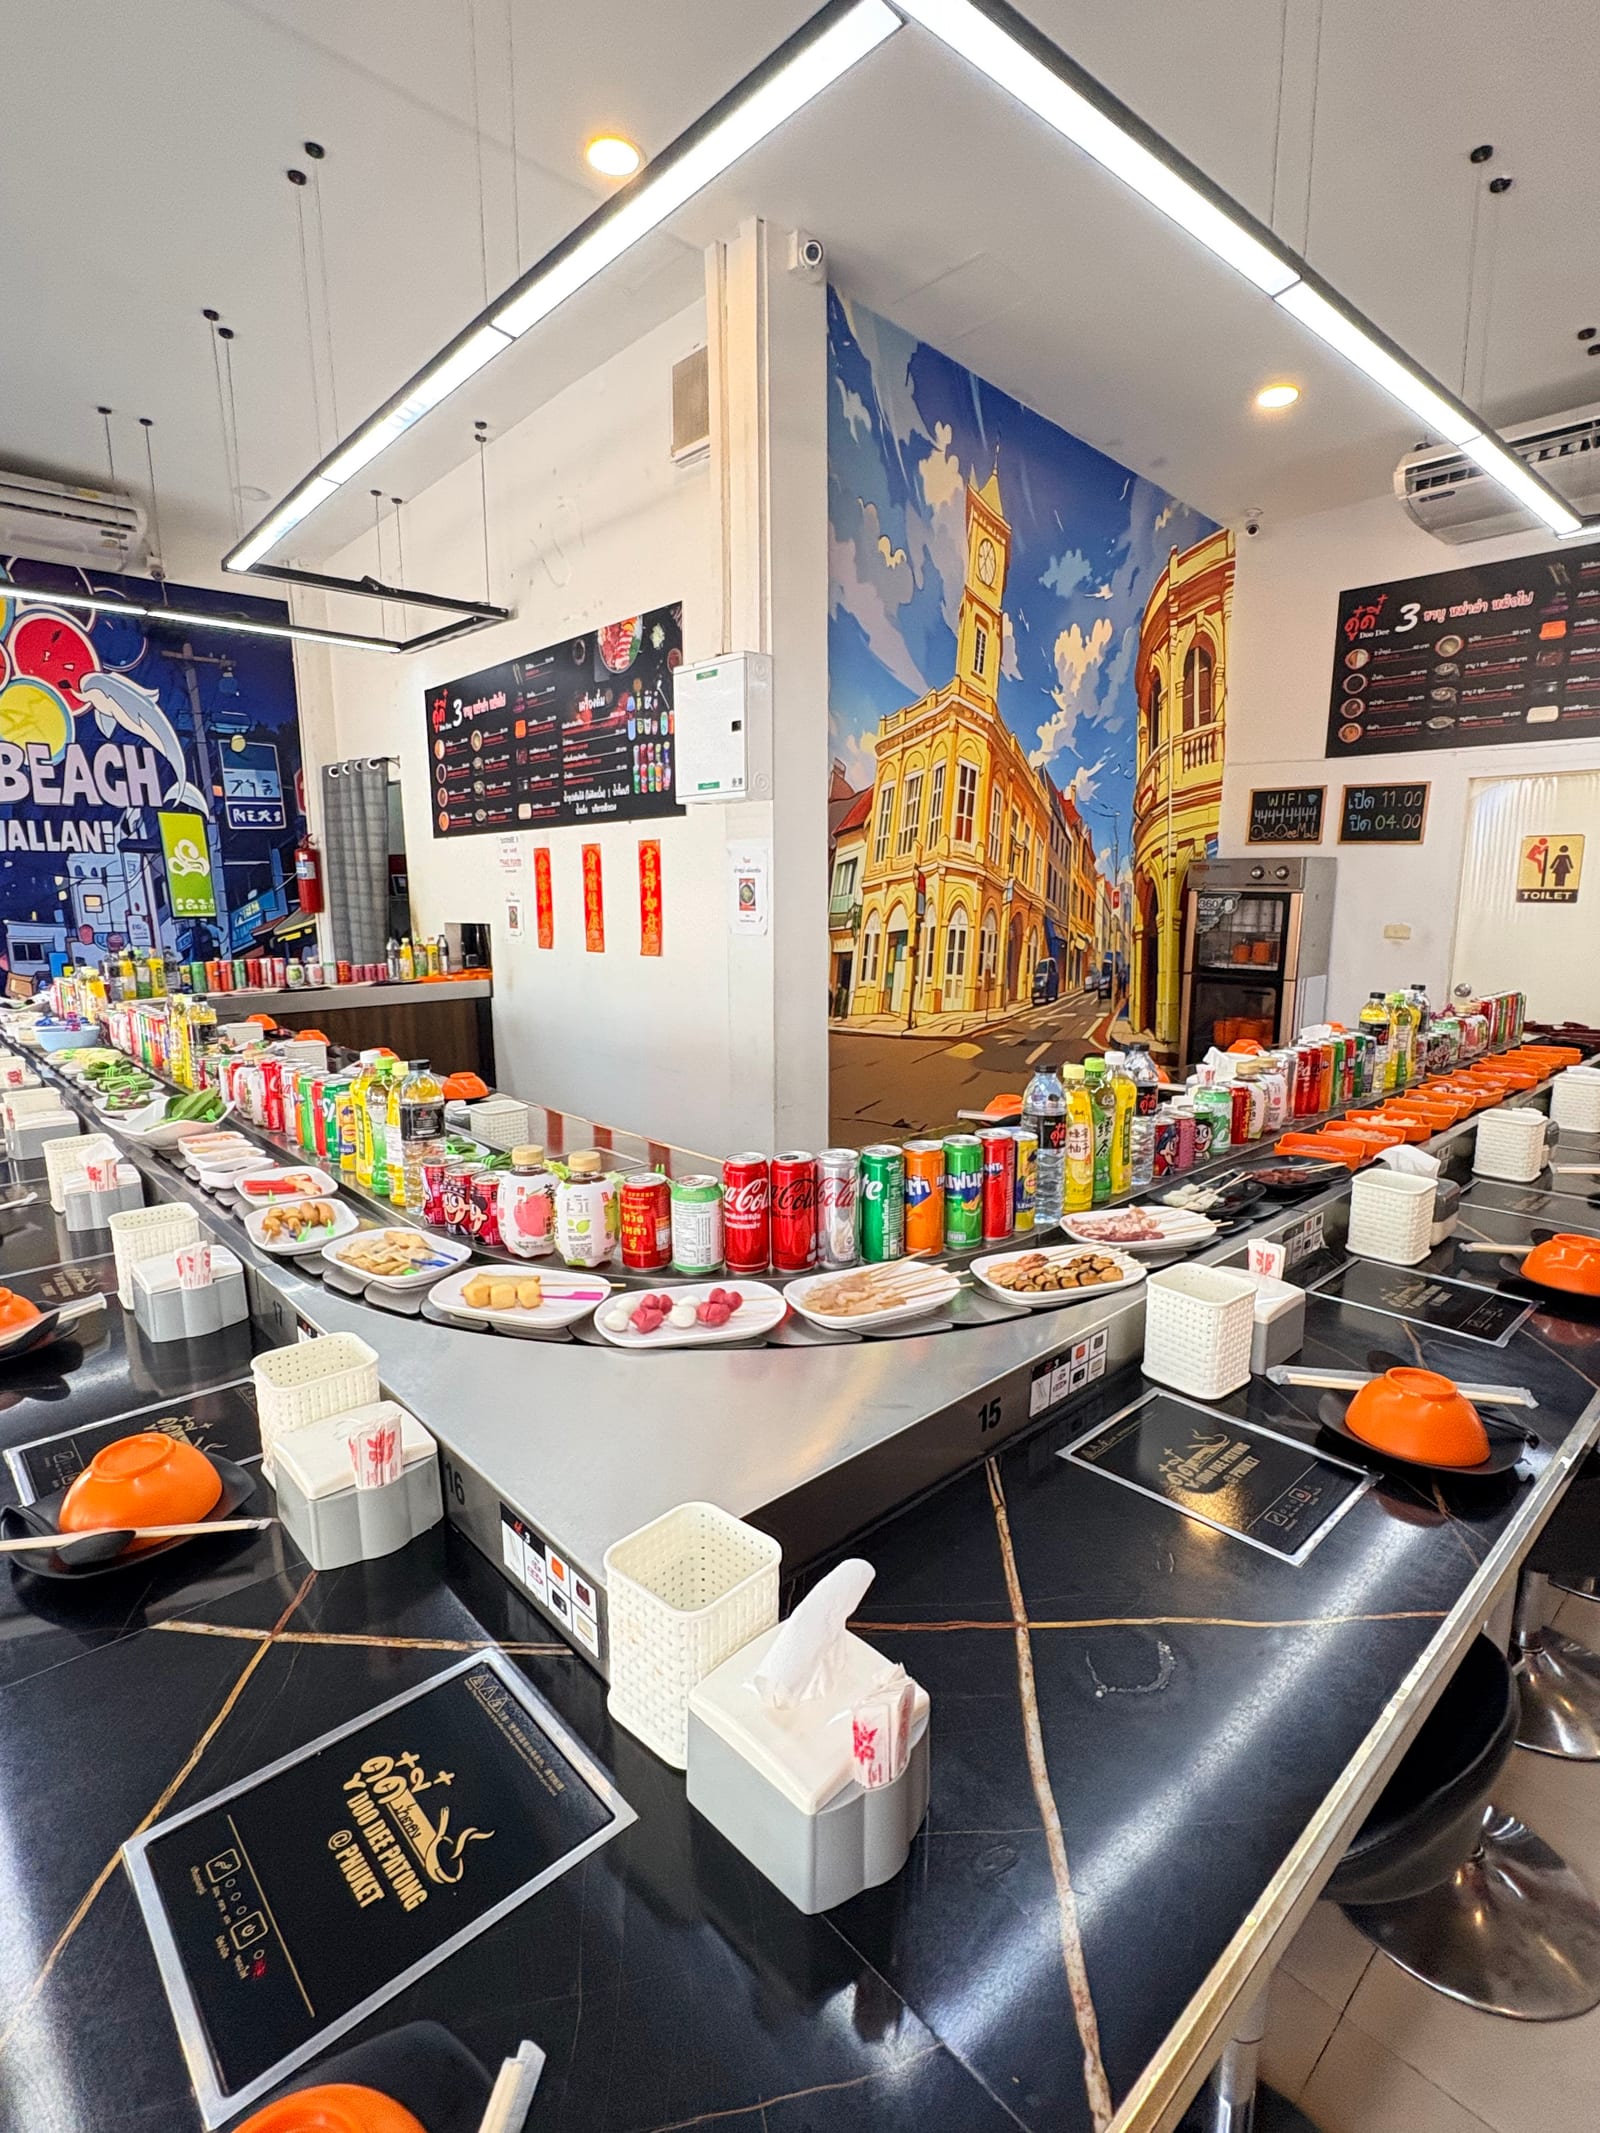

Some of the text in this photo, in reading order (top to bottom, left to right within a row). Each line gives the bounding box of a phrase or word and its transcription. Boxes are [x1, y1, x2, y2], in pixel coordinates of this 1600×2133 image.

[1395, 603, 1421, 633] 3
[453, 698, 463, 728] 3
[0, 743, 163, 807] BEACH
[1267, 792, 1302, 807] WIFI
[1348, 789, 1423, 809] เปิด 11.00
[1349, 813, 1421, 831] ปิด 04.00
[1522, 891, 1573, 900] TOILET
[978, 1396, 1002, 1432] 15
[447, 1461, 465, 1505] 16
[346, 1790, 428, 1912] DOO DEE PATONG
[328, 1829, 386, 1909] @ PHUKET
